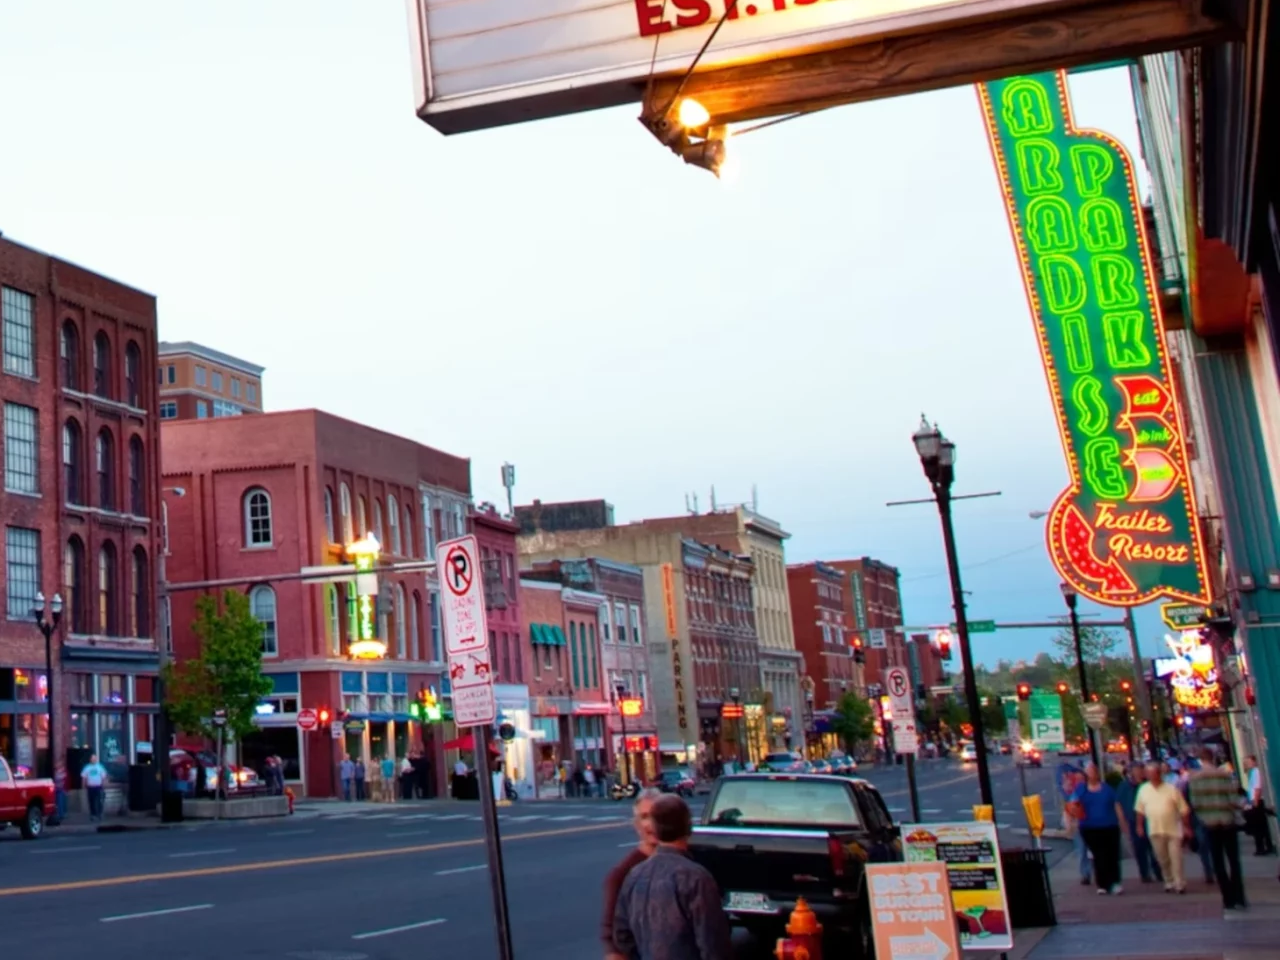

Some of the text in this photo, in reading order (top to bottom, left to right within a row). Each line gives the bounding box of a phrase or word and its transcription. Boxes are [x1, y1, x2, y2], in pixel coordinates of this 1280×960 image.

[1070, 143, 1152, 369] PARK
[1002, 76, 1127, 500] ARADISE
[1094, 502, 1173, 533] Trailer
[1109, 532, 1190, 565] Resort
[671, 638, 688, 730] PARKING
[871, 872, 941, 894] BEST
[874, 894, 945, 910] BURGER
